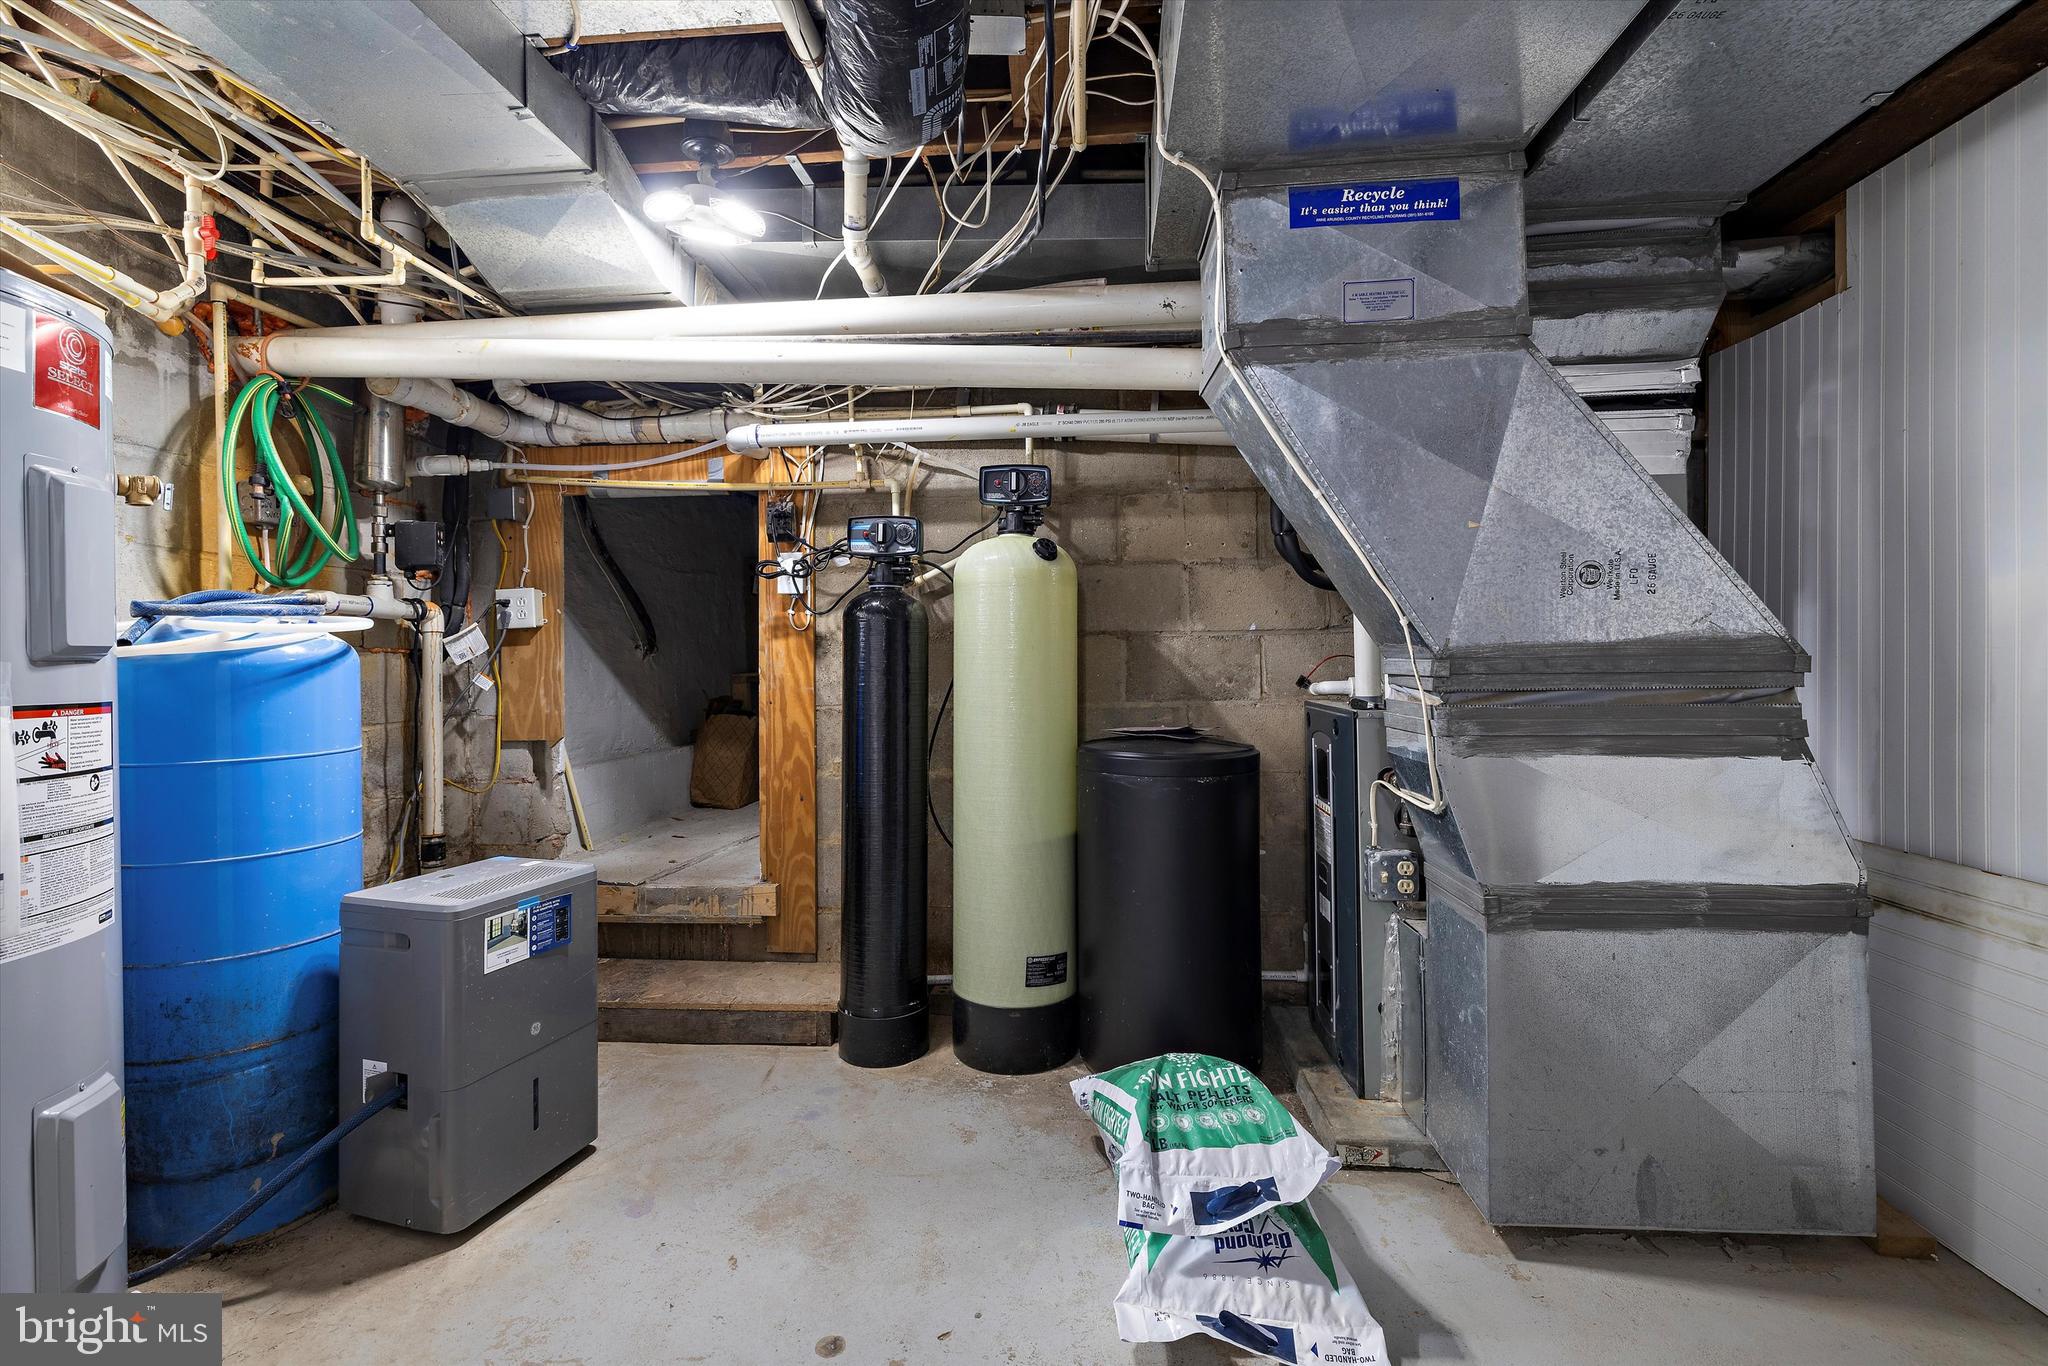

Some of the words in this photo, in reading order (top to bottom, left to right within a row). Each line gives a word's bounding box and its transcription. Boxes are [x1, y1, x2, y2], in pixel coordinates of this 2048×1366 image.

[1686, 11, 1728, 19] GAUGE
[1341, 187, 1405, 203] Recycle
[1301, 206, 1318, 216] It's
[1322, 205, 1355, 215] easier
[1360, 203, 1385, 213] than
[1390, 203, 1409, 213] you
[1414, 199, 1449, 210] think!
[48, 367, 95, 392] SELECT
[1647, 552, 1656, 580] GAUGE
[1567, 553, 1575, 595] Corporation
[1647, 583, 1656, 595] 26
[43, 830, 70, 839] IMPORTANT
[1187, 1085, 1252, 1102] PELLETS
[1167, 1101, 1199, 1112] WATER
[1142, 1201, 1155, 1210] BAG
[1214, 1231, 1293, 1254] Diamond
[1203, 1273, 1236, 1282] 1886
[1247, 1277, 1291, 1288] SINCE
[1342, 1347, 1356, 1356] BAG
[1324, 1354, 1376, 1364] TWO-HANDLED
